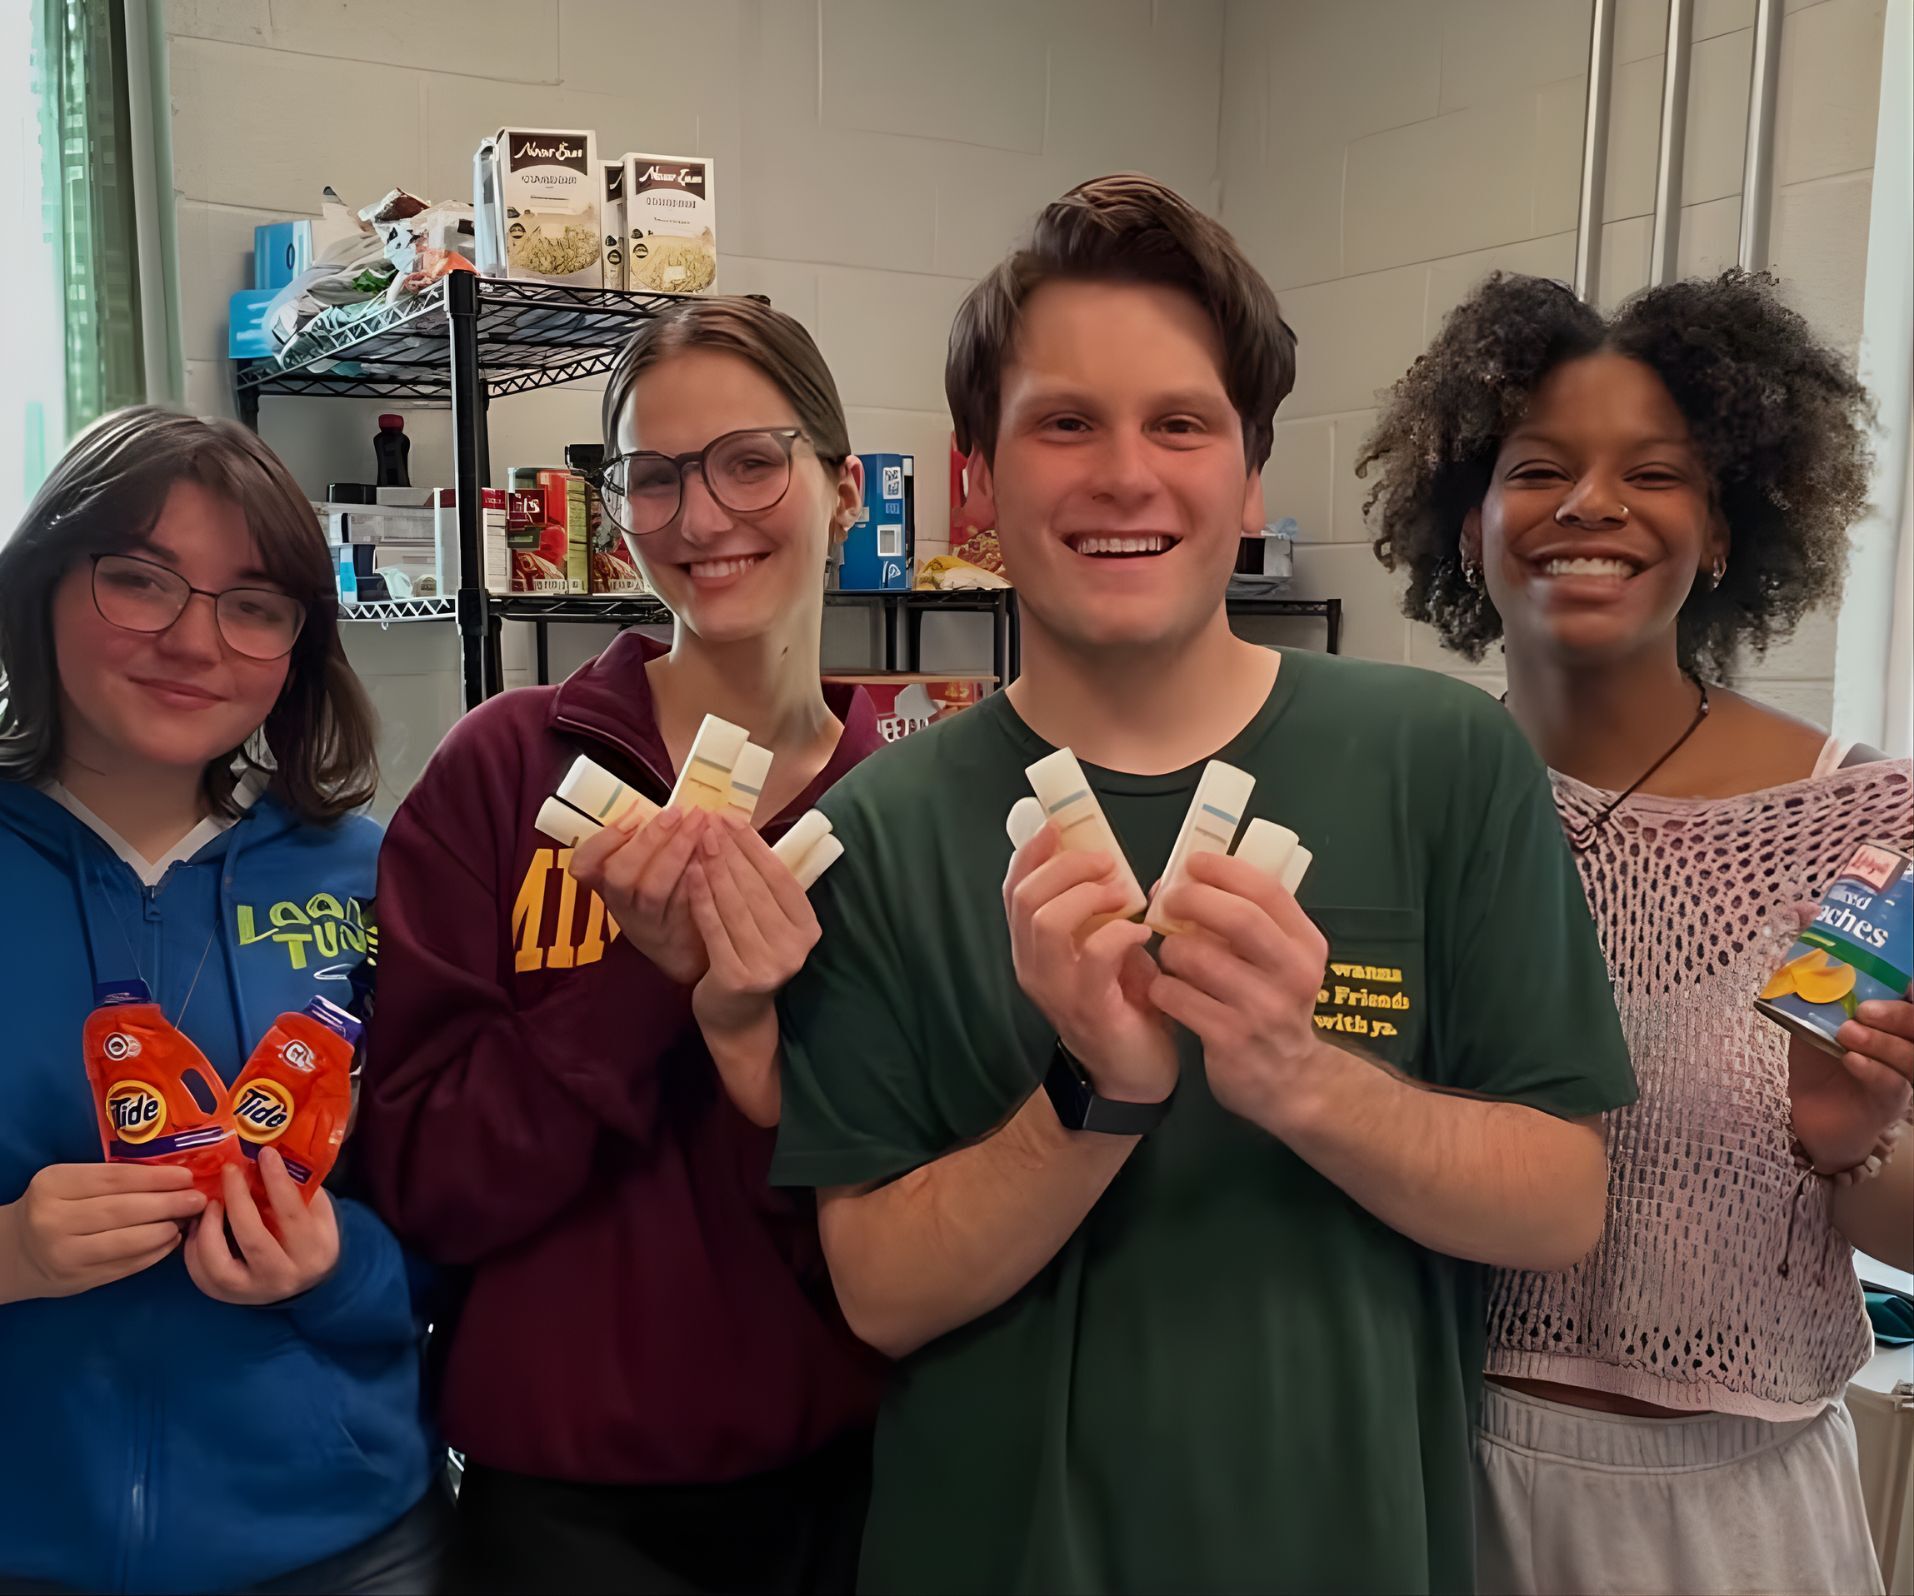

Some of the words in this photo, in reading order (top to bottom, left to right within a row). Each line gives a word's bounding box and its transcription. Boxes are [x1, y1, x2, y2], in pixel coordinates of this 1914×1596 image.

[1334, 985, 1410, 1010] Friends
[1313, 1013, 1368, 1034] with
[109, 1092, 160, 1131] Tide
[232, 1086, 288, 1128] Tide
